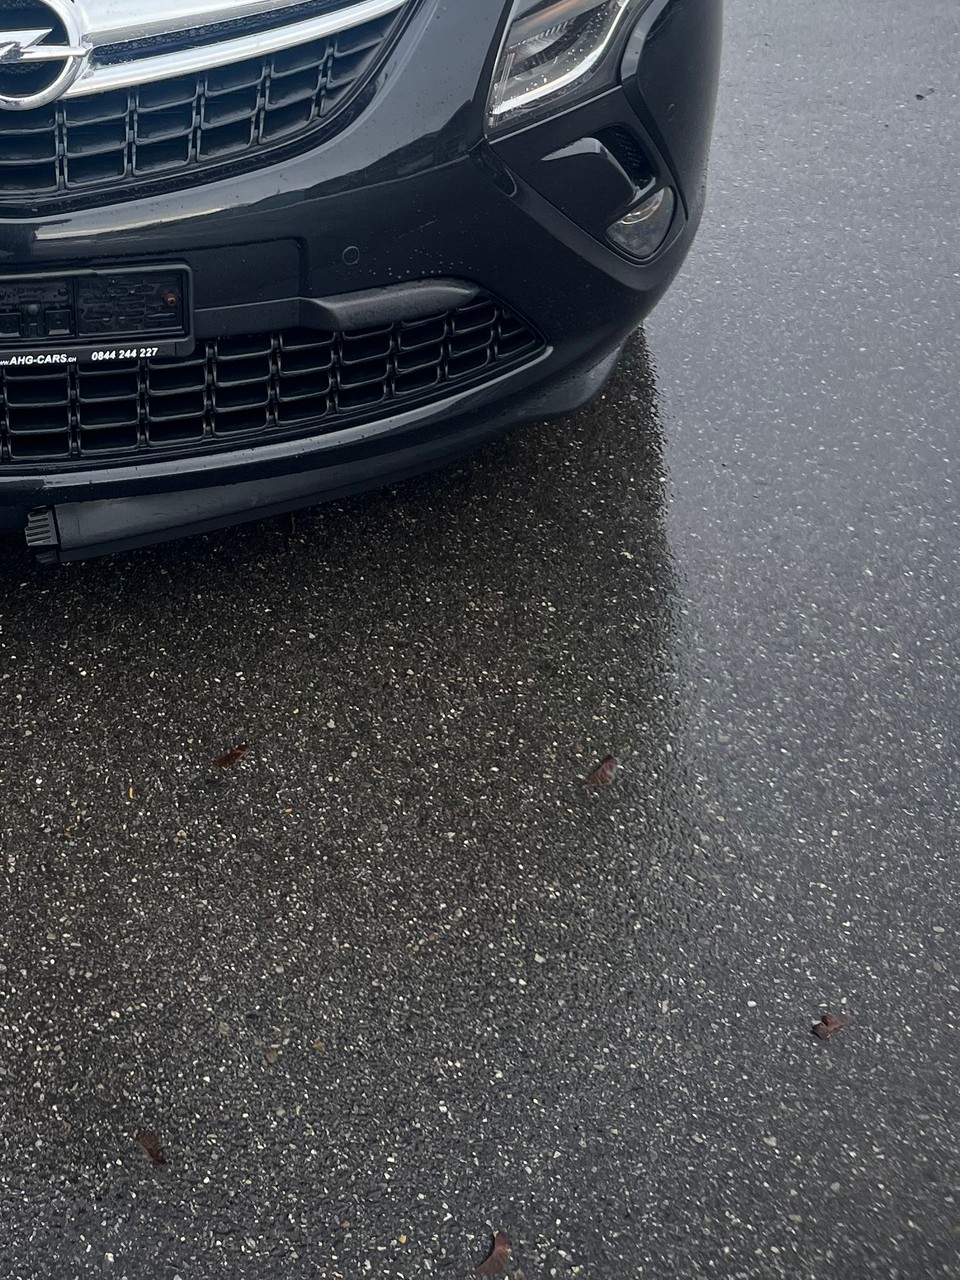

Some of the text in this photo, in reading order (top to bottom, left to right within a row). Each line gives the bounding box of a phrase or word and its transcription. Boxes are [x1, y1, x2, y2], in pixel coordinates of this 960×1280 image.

[91, 350, 116, 361] 0844
[118, 348, 137, 359] 244
[139, 347, 158, 358] 227
